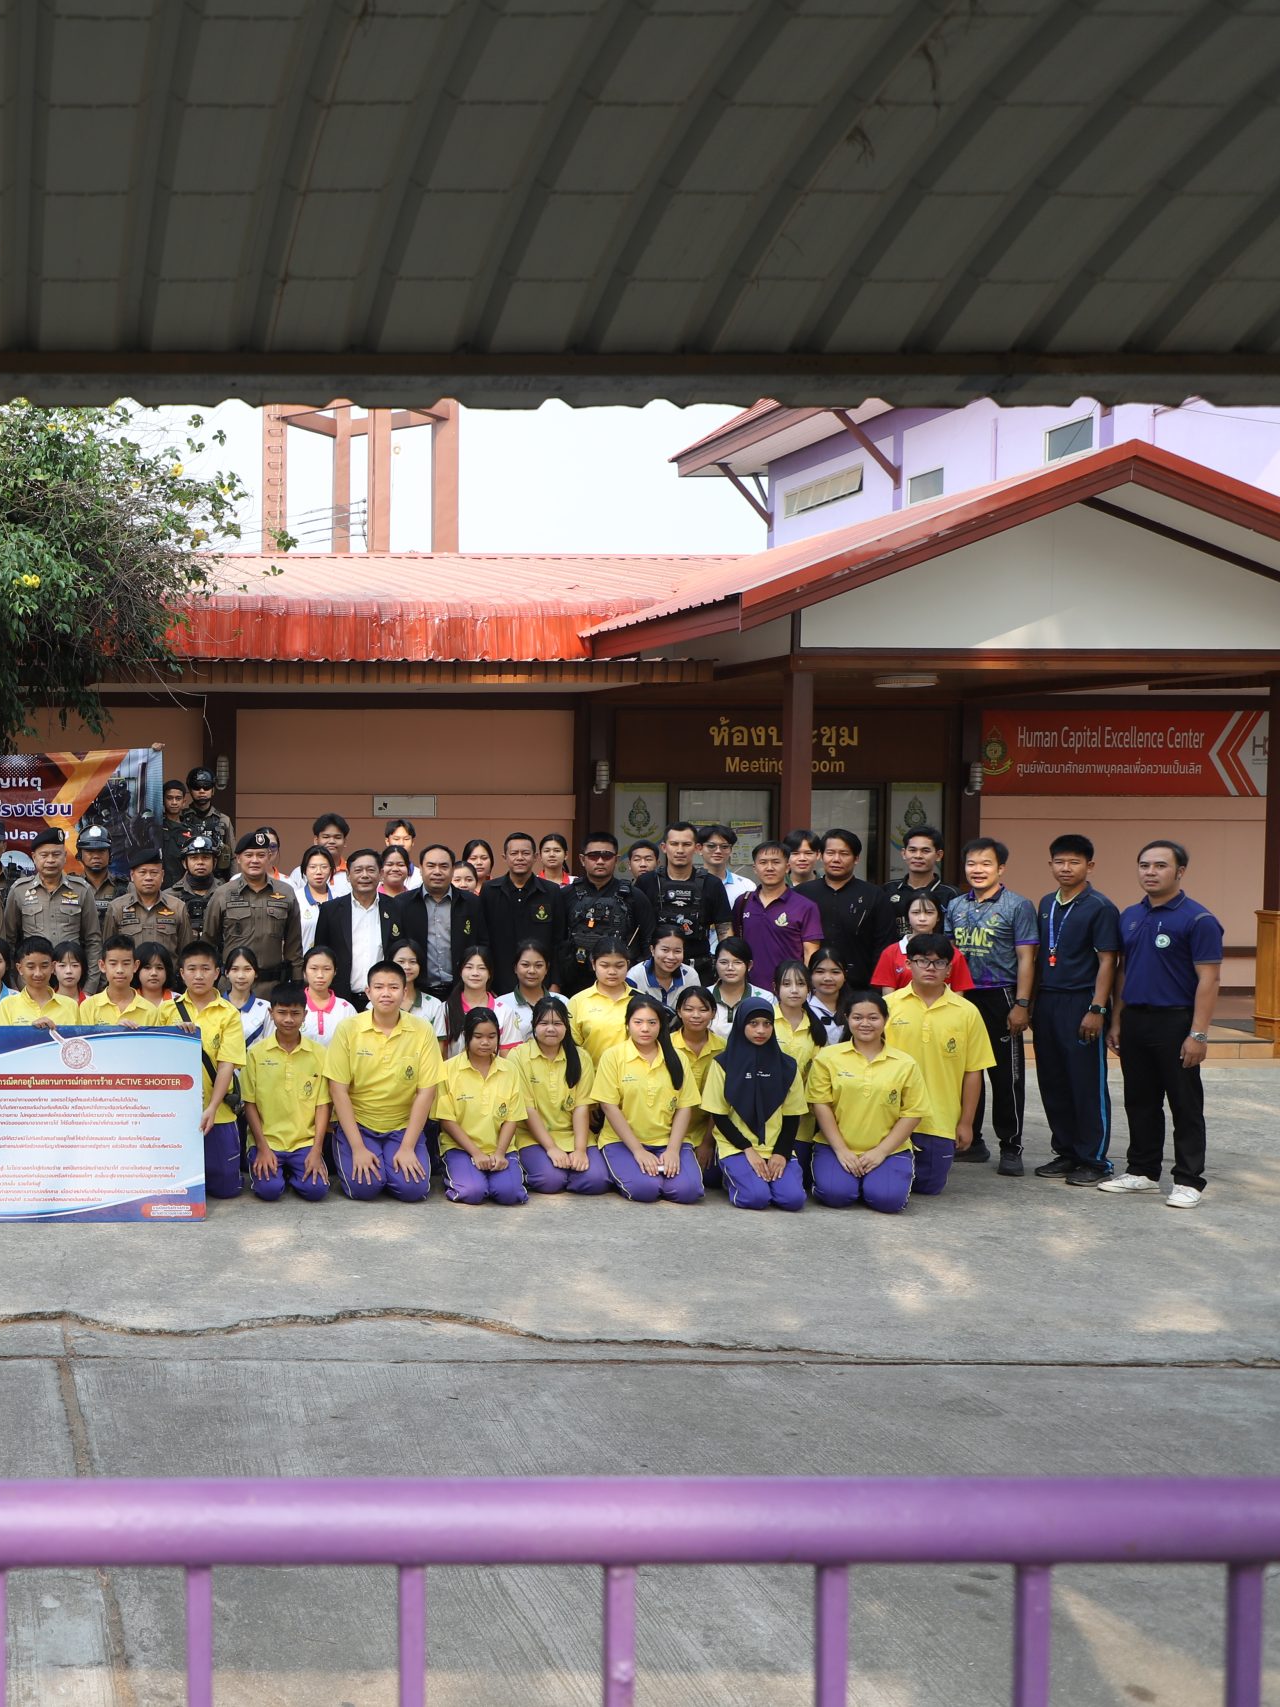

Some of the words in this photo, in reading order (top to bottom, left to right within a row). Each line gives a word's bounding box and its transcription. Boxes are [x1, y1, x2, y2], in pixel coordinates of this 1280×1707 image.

[1017, 726, 1058, 748] Human
[1061, 726, 1102, 754] Capital
[1104, 726, 1165, 748] Excellence
[1167, 726, 1205, 748] Center
[115, 1078, 142, 1086] ACTIVE
[144, 1078, 181, 1086] SHOOTER
